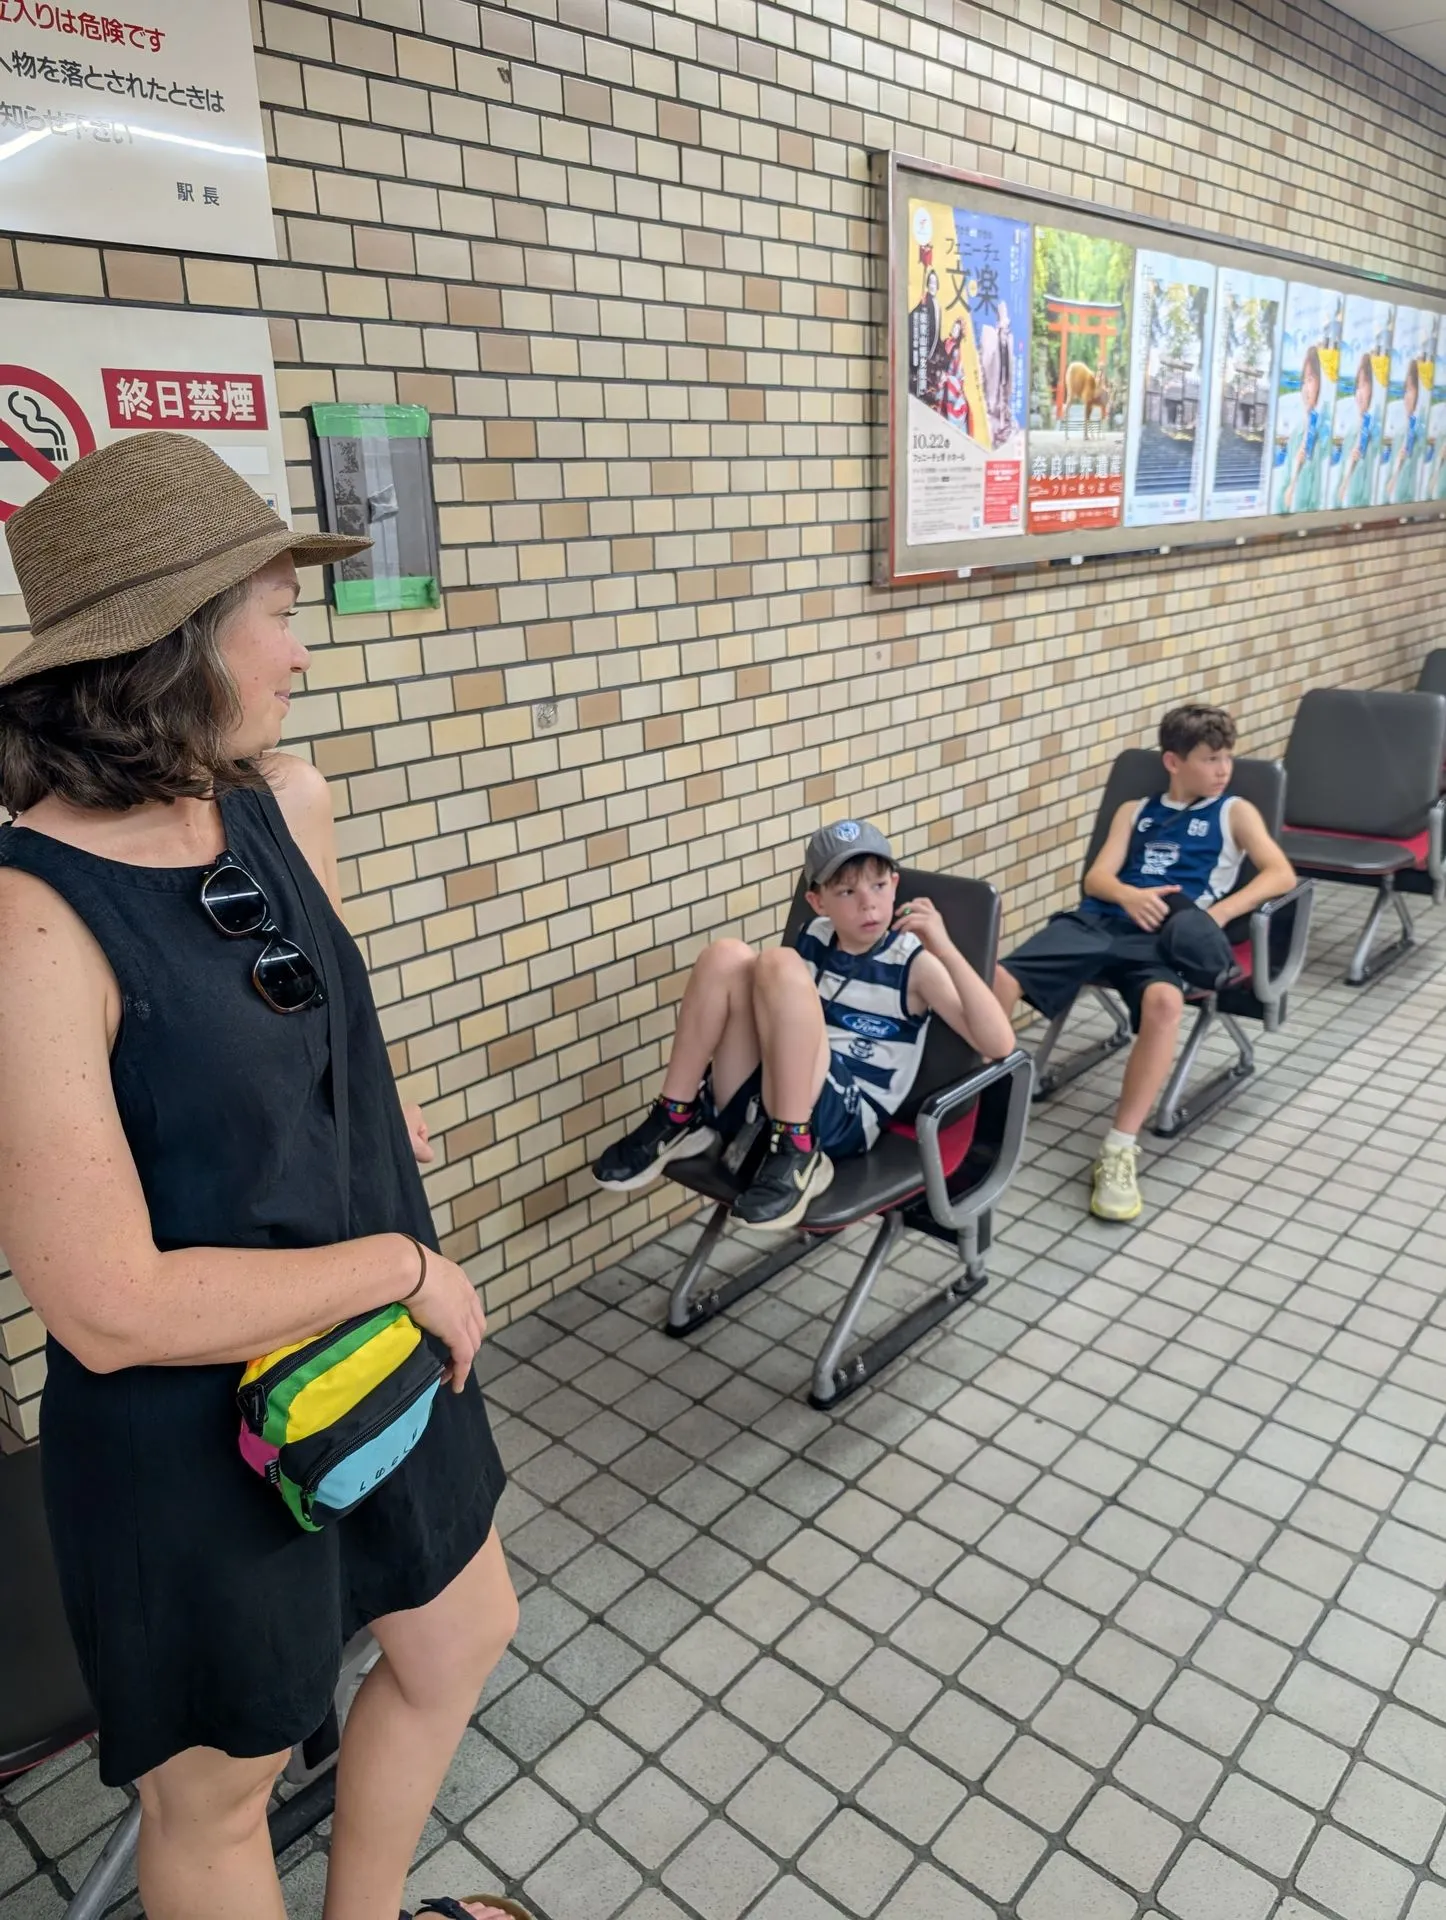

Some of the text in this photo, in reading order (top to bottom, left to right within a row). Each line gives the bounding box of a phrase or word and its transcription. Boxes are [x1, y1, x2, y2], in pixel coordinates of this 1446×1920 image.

[116, 376, 257, 423] 終日禁煙
[850, 1016, 891, 1036] Ford
